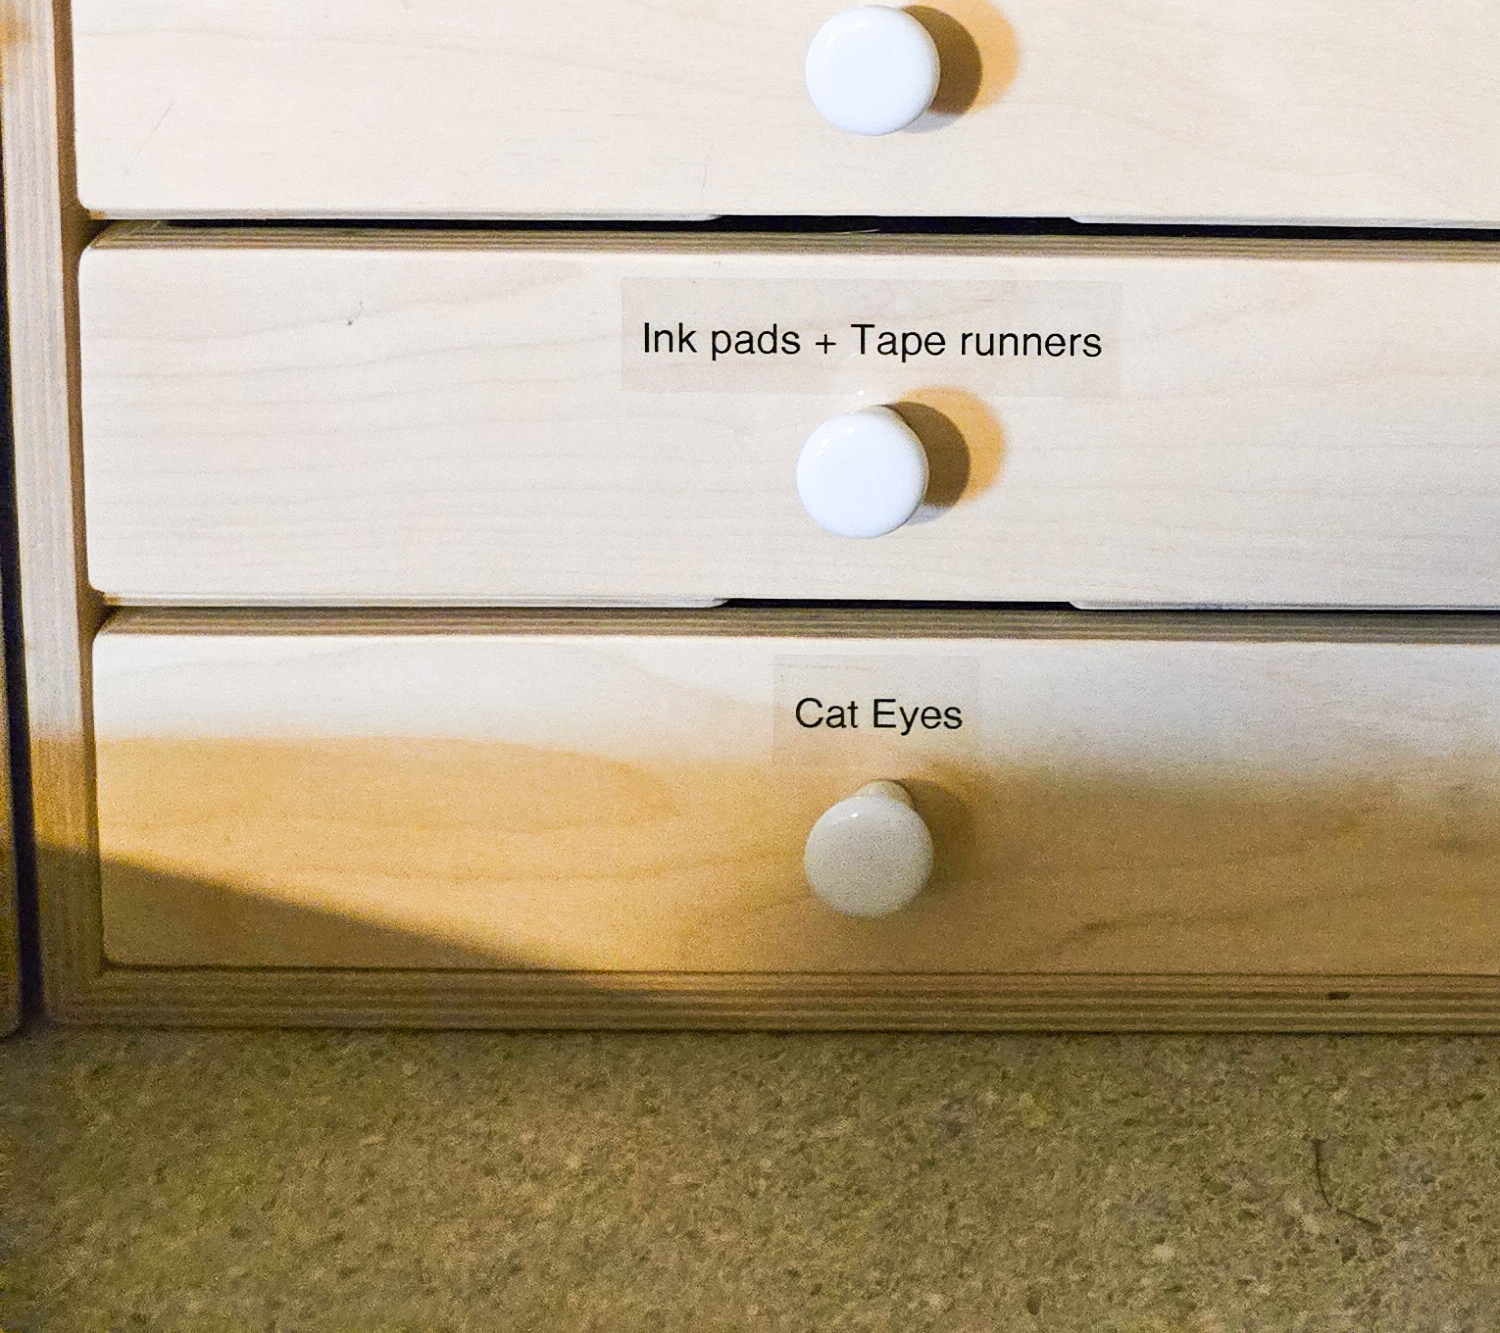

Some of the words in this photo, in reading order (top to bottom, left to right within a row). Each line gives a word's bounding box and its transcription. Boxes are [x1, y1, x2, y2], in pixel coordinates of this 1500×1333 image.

[644, 322, 698, 353] Ink
[711, 323, 801, 362] pads
[815, 333, 837, 355] +
[850, 323, 946, 364] Tape
[961, 332, 1102, 358] runners
[795, 697, 859, 729] Cat
[873, 698, 963, 737] Eyes
